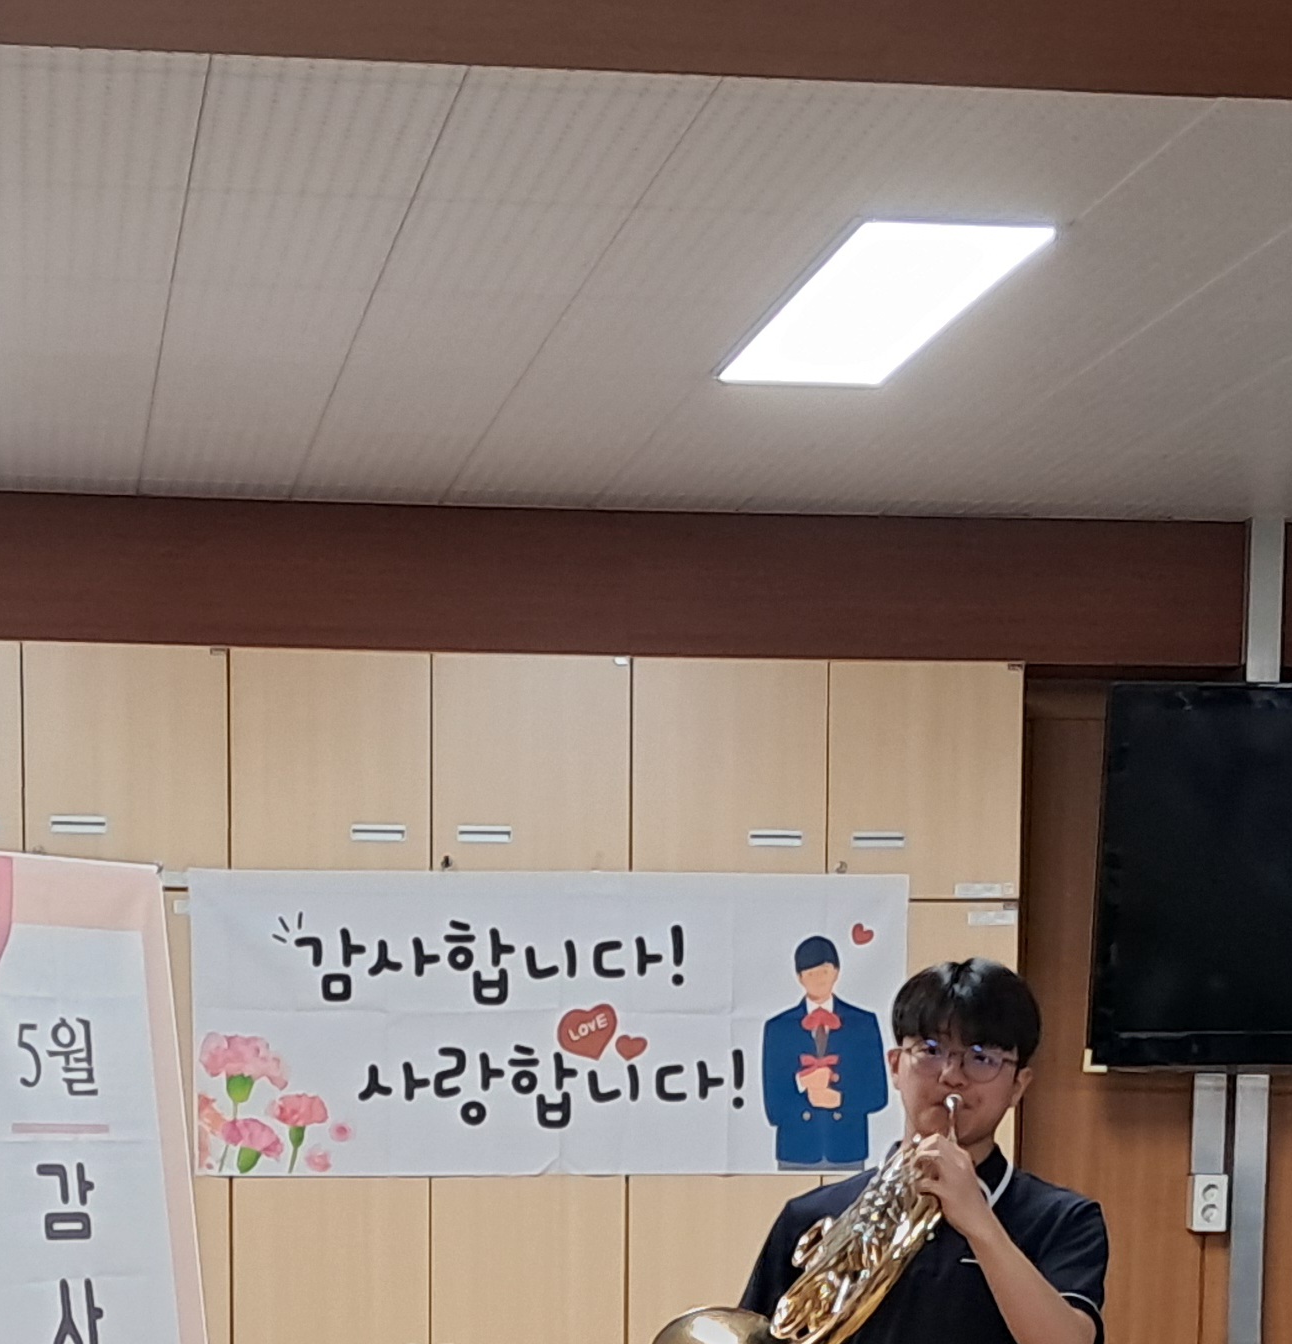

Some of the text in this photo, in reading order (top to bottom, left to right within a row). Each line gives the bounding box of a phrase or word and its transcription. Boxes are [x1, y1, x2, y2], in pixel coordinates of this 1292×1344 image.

[294, 920, 687, 1006] 감사합니다!
[16, 1016, 100, 1097] 5월
[567, 1013, 610, 1042] LOVE
[358, 1044, 746, 1129] 사랑합니다!
